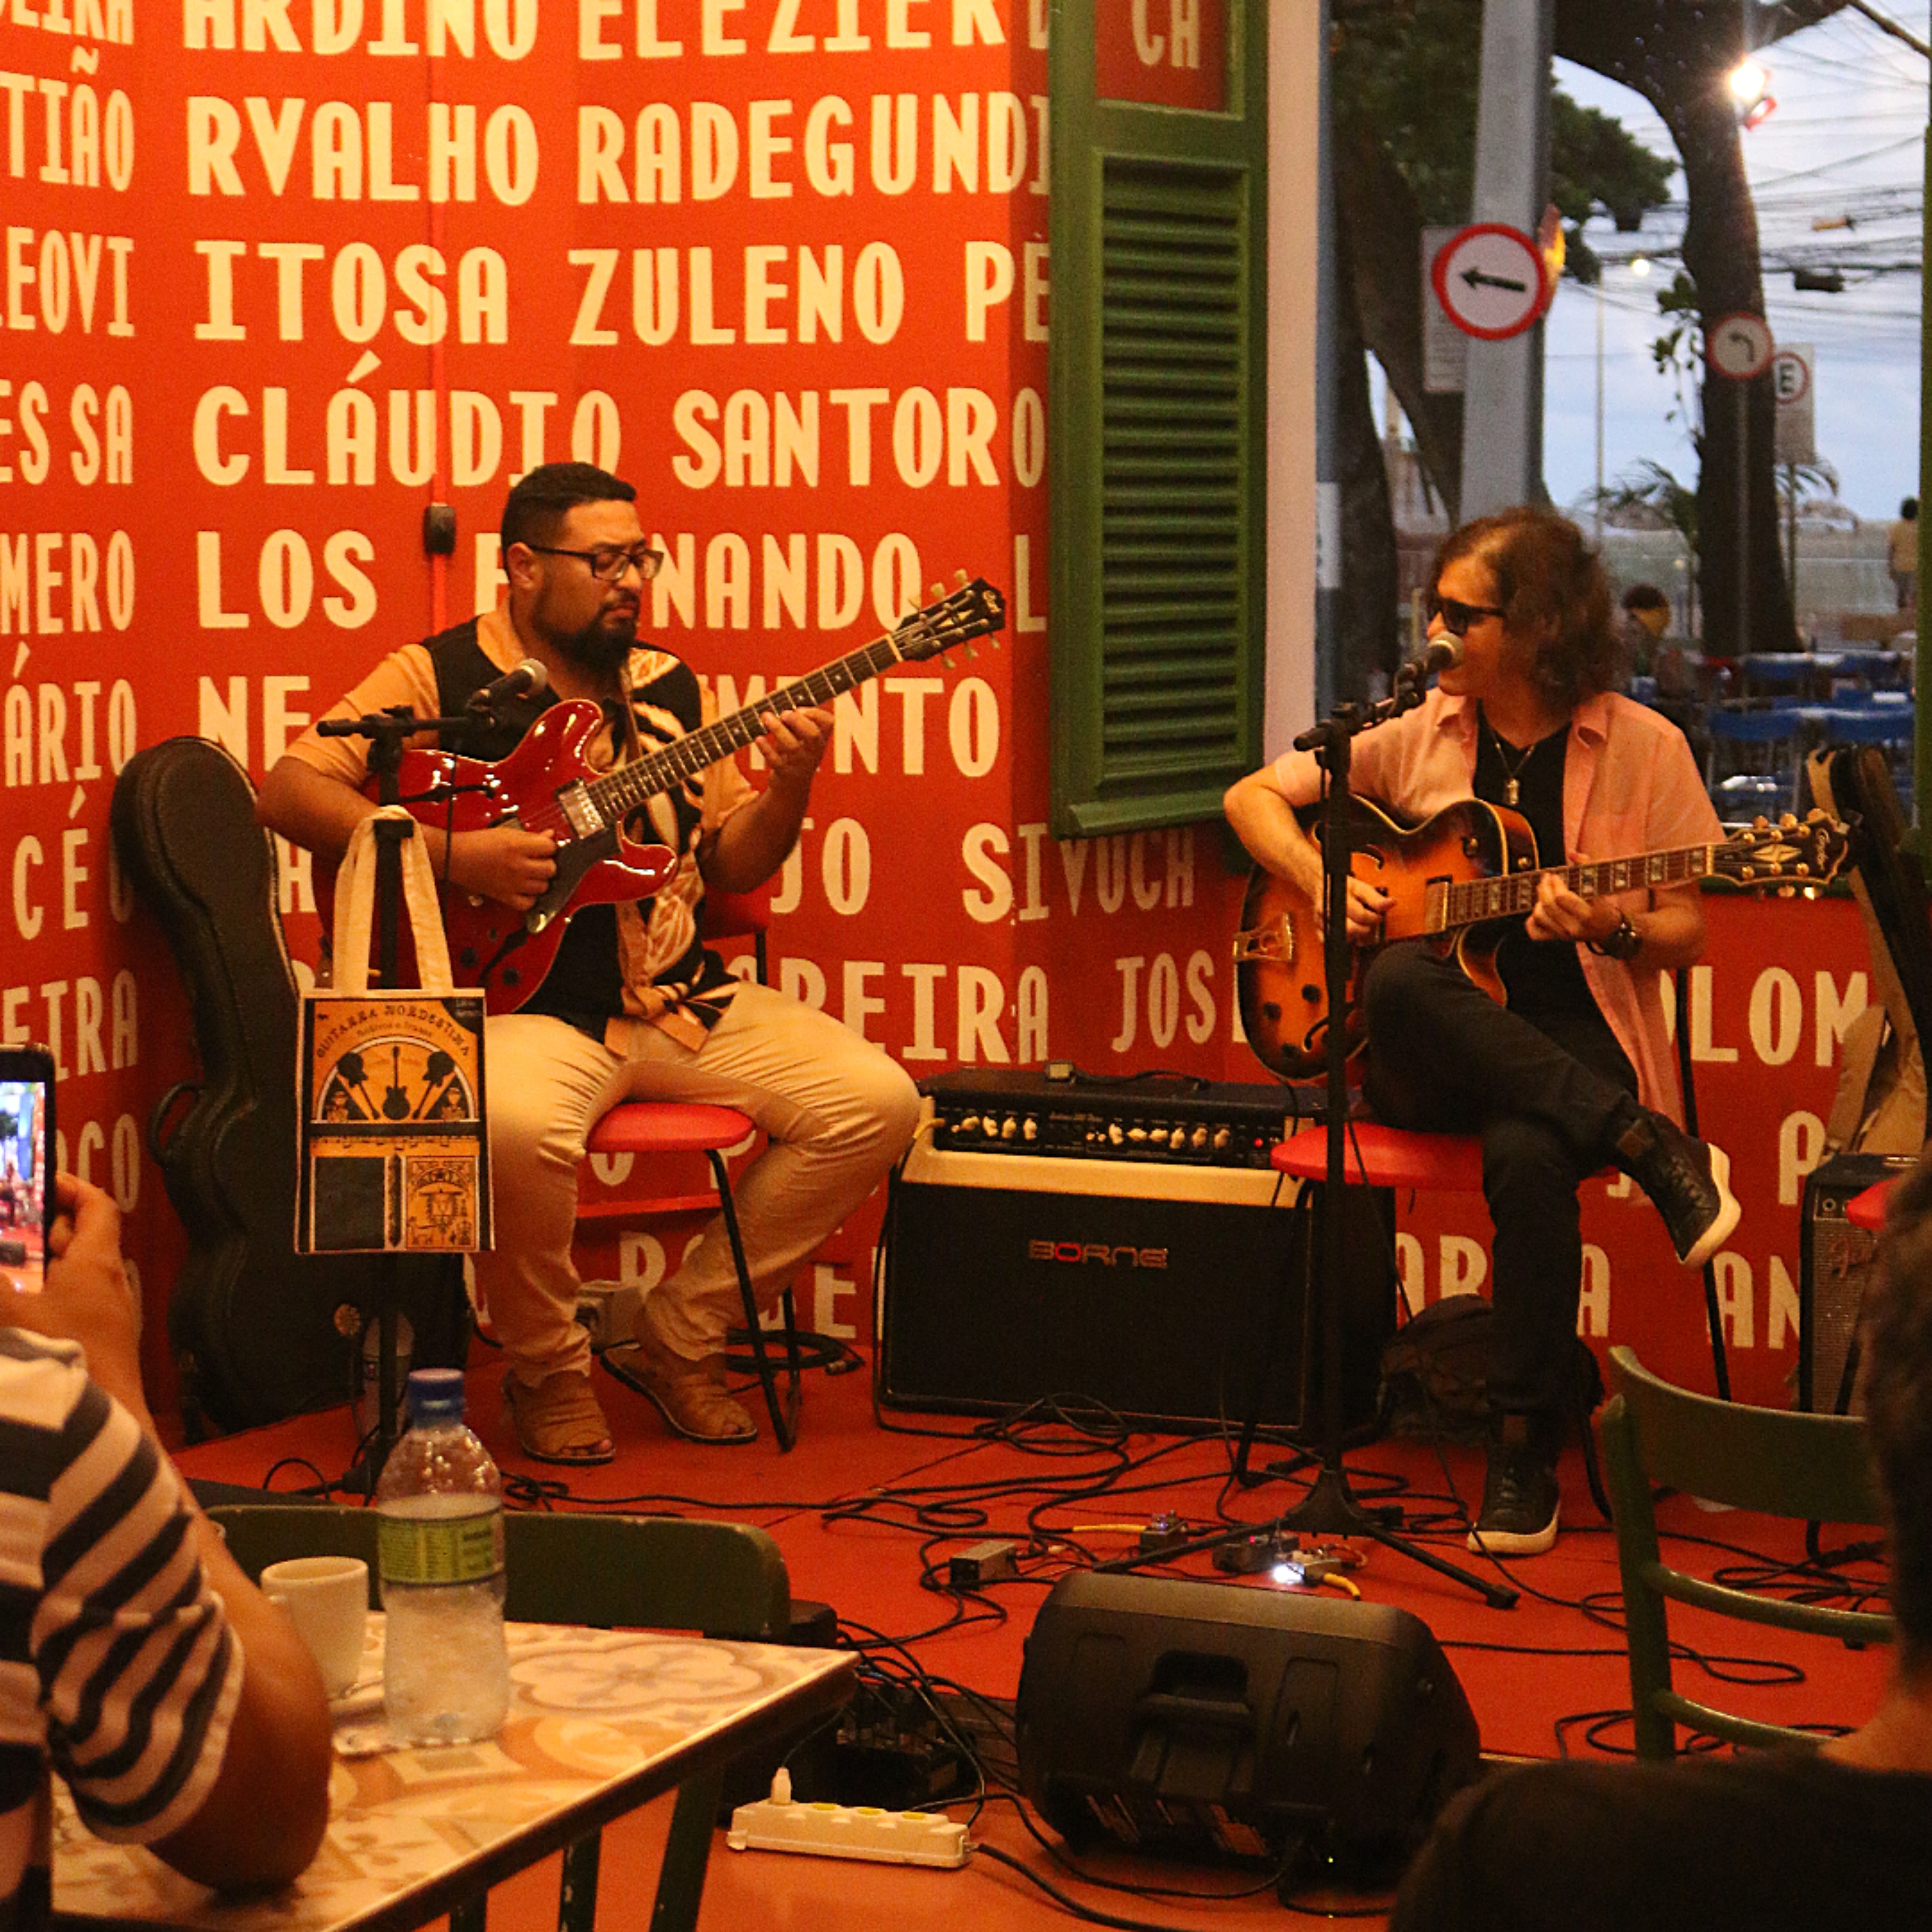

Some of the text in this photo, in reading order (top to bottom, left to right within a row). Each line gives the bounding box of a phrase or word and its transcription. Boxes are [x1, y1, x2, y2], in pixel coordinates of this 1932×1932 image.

[0, 44, 134, 192] TIÃO
[187, 96, 539, 205] RVALHO
[0, 226, 135, 337] EOVI
[194, 240, 508, 345] ITOSA
[568, 241, 904, 345] ZULENO
[193, 350, 1045, 488] CLÁUDIO SANTORO
[0, 530, 135, 634] MERO
[197, 529, 377, 629] LOS
[4, 641, 137, 787] ÁRIO
